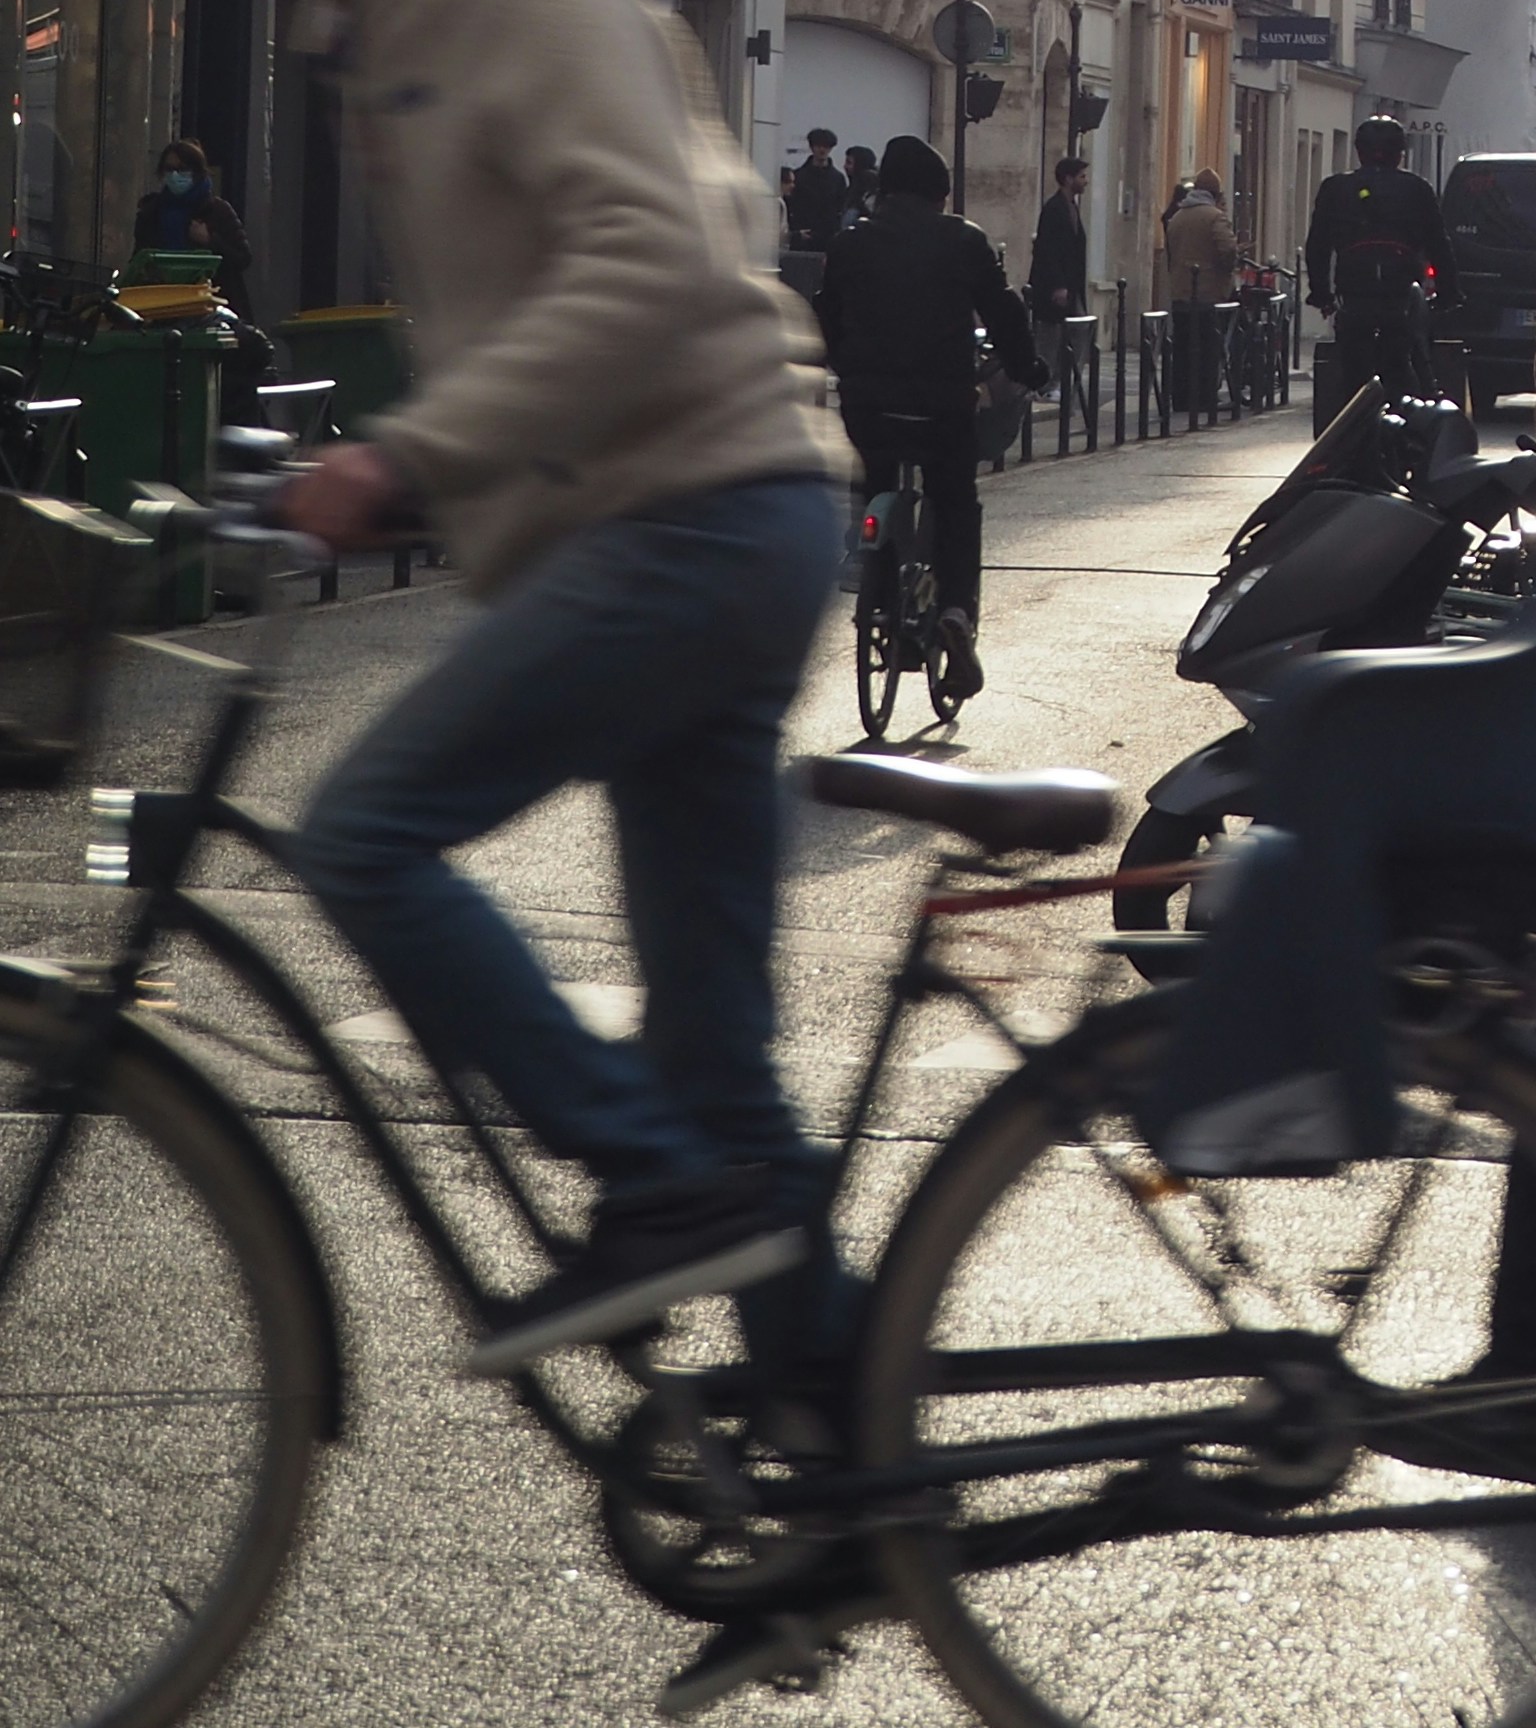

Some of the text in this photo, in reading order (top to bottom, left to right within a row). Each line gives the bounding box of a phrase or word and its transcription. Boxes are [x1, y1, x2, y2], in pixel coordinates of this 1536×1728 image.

[1260, 32, 1327, 45] SAINT JAMES
[1409, 121, 1448, 133] A.P.C.
